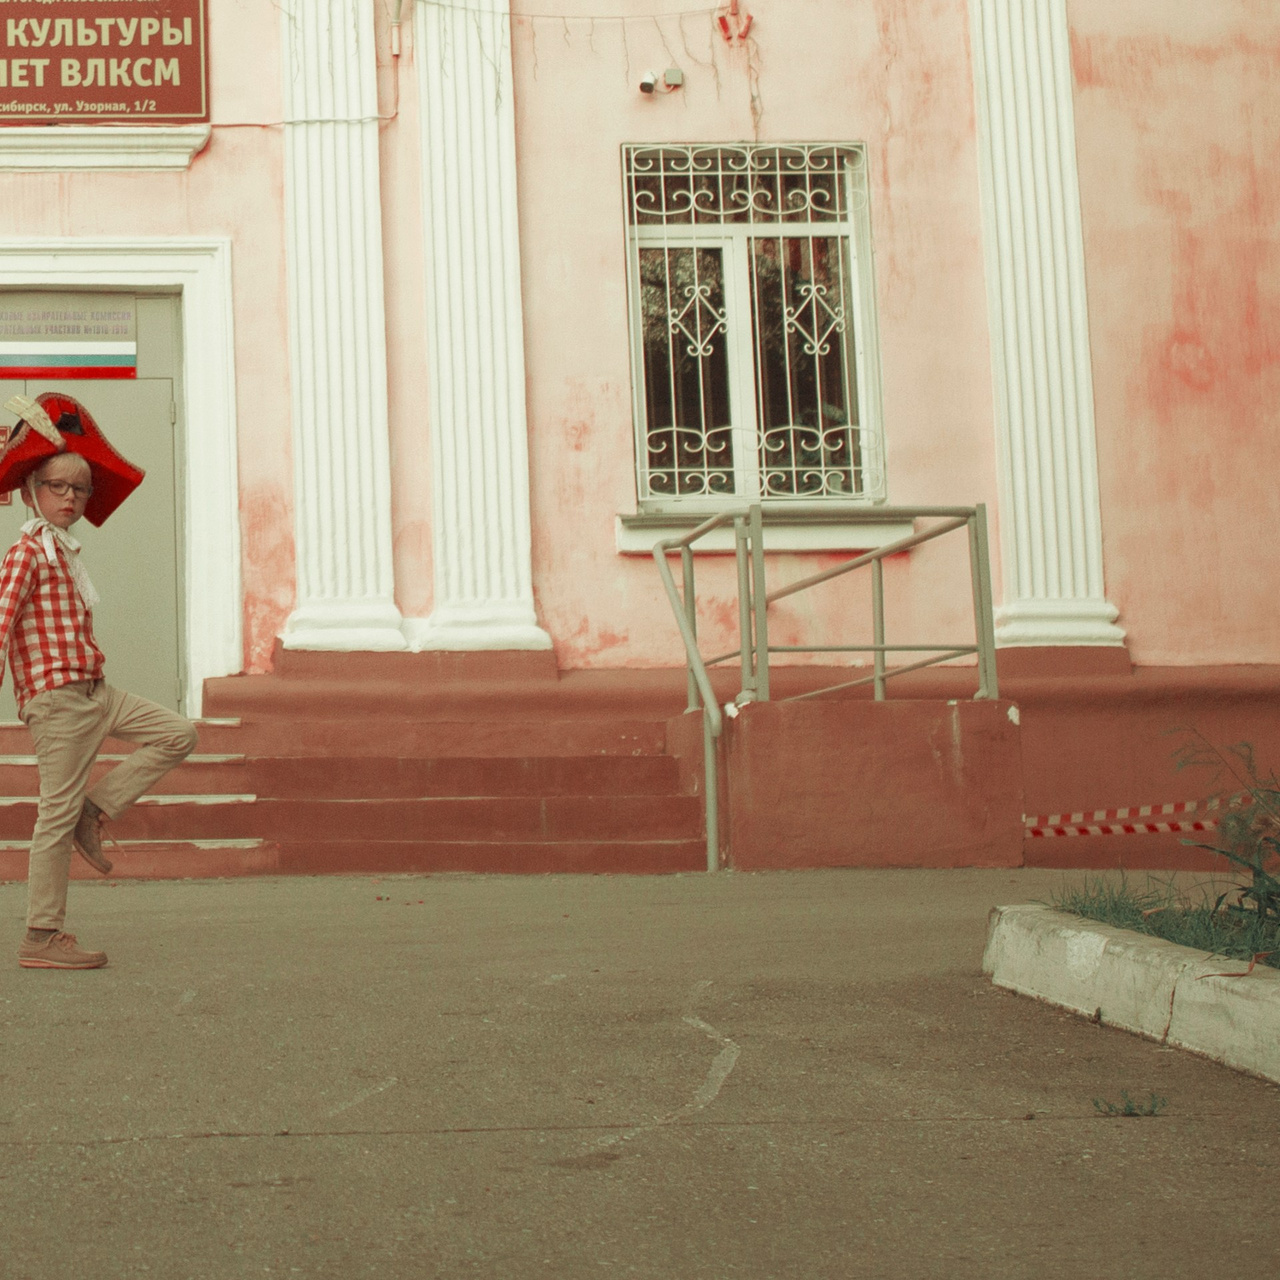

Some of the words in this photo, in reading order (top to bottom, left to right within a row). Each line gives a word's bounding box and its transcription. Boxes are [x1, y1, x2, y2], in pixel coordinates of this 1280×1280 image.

[6, 17, 193, 48] КУЛЬТУРЫ
[61, 58, 181, 87] ВЛКСМ
[54, 101, 73, 115] ул.
[76, 100, 130, 114] Узорная,
[134, 100, 157, 113] 1/2
